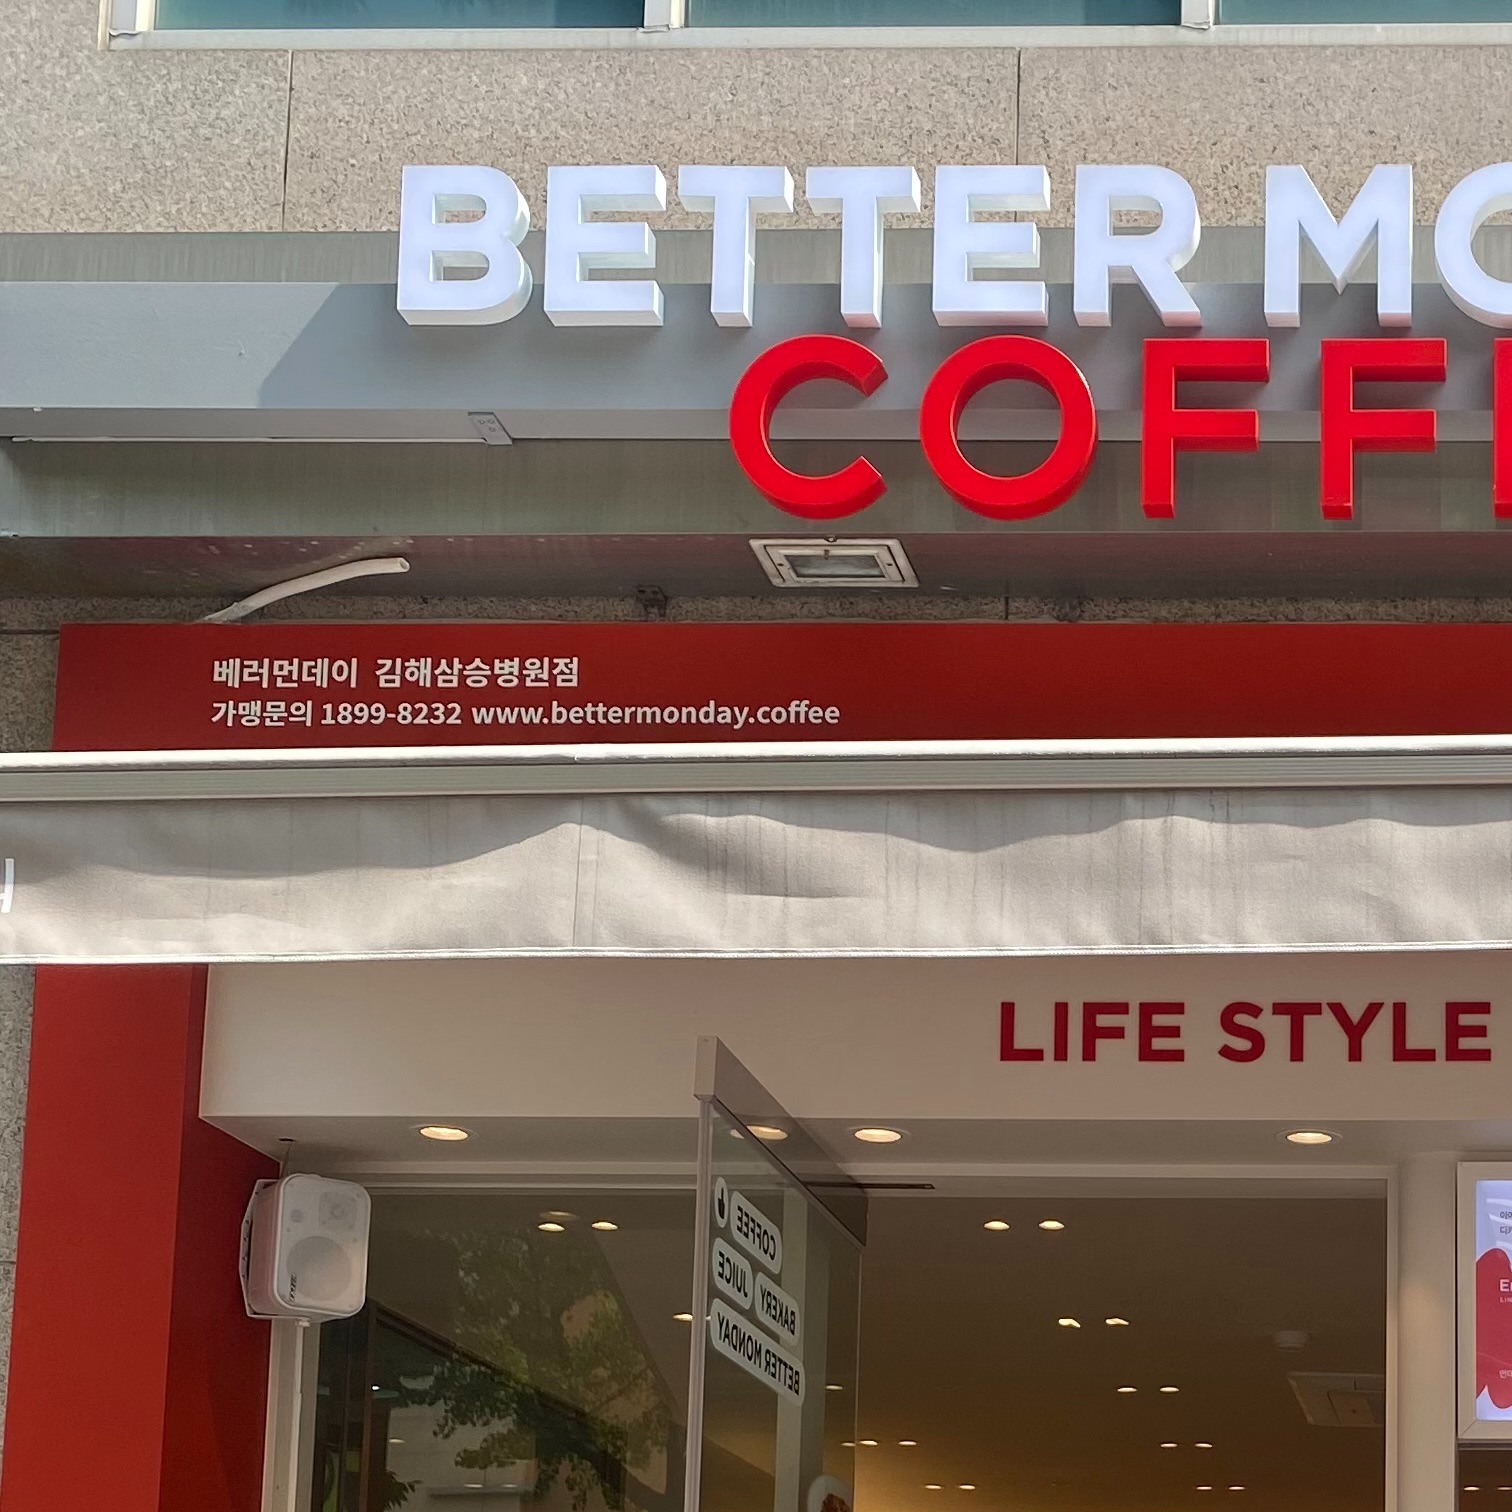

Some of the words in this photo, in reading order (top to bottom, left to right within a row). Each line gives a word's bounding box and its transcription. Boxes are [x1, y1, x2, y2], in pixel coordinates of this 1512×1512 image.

[397, 164, 1203, 327] BETTER
[212, 658, 358, 689] 베러먼데이
[374, 658, 580, 688] 김해삼승병원점
[211, 701, 313, 727] 가맹문의
[321, 702, 462, 726] 1899-8232
[472, 700, 841, 730] www.bettermonday.coffee
[998, 1001, 1187, 1063] LIFE
[1217, 1001, 1492, 1063] STYLE
